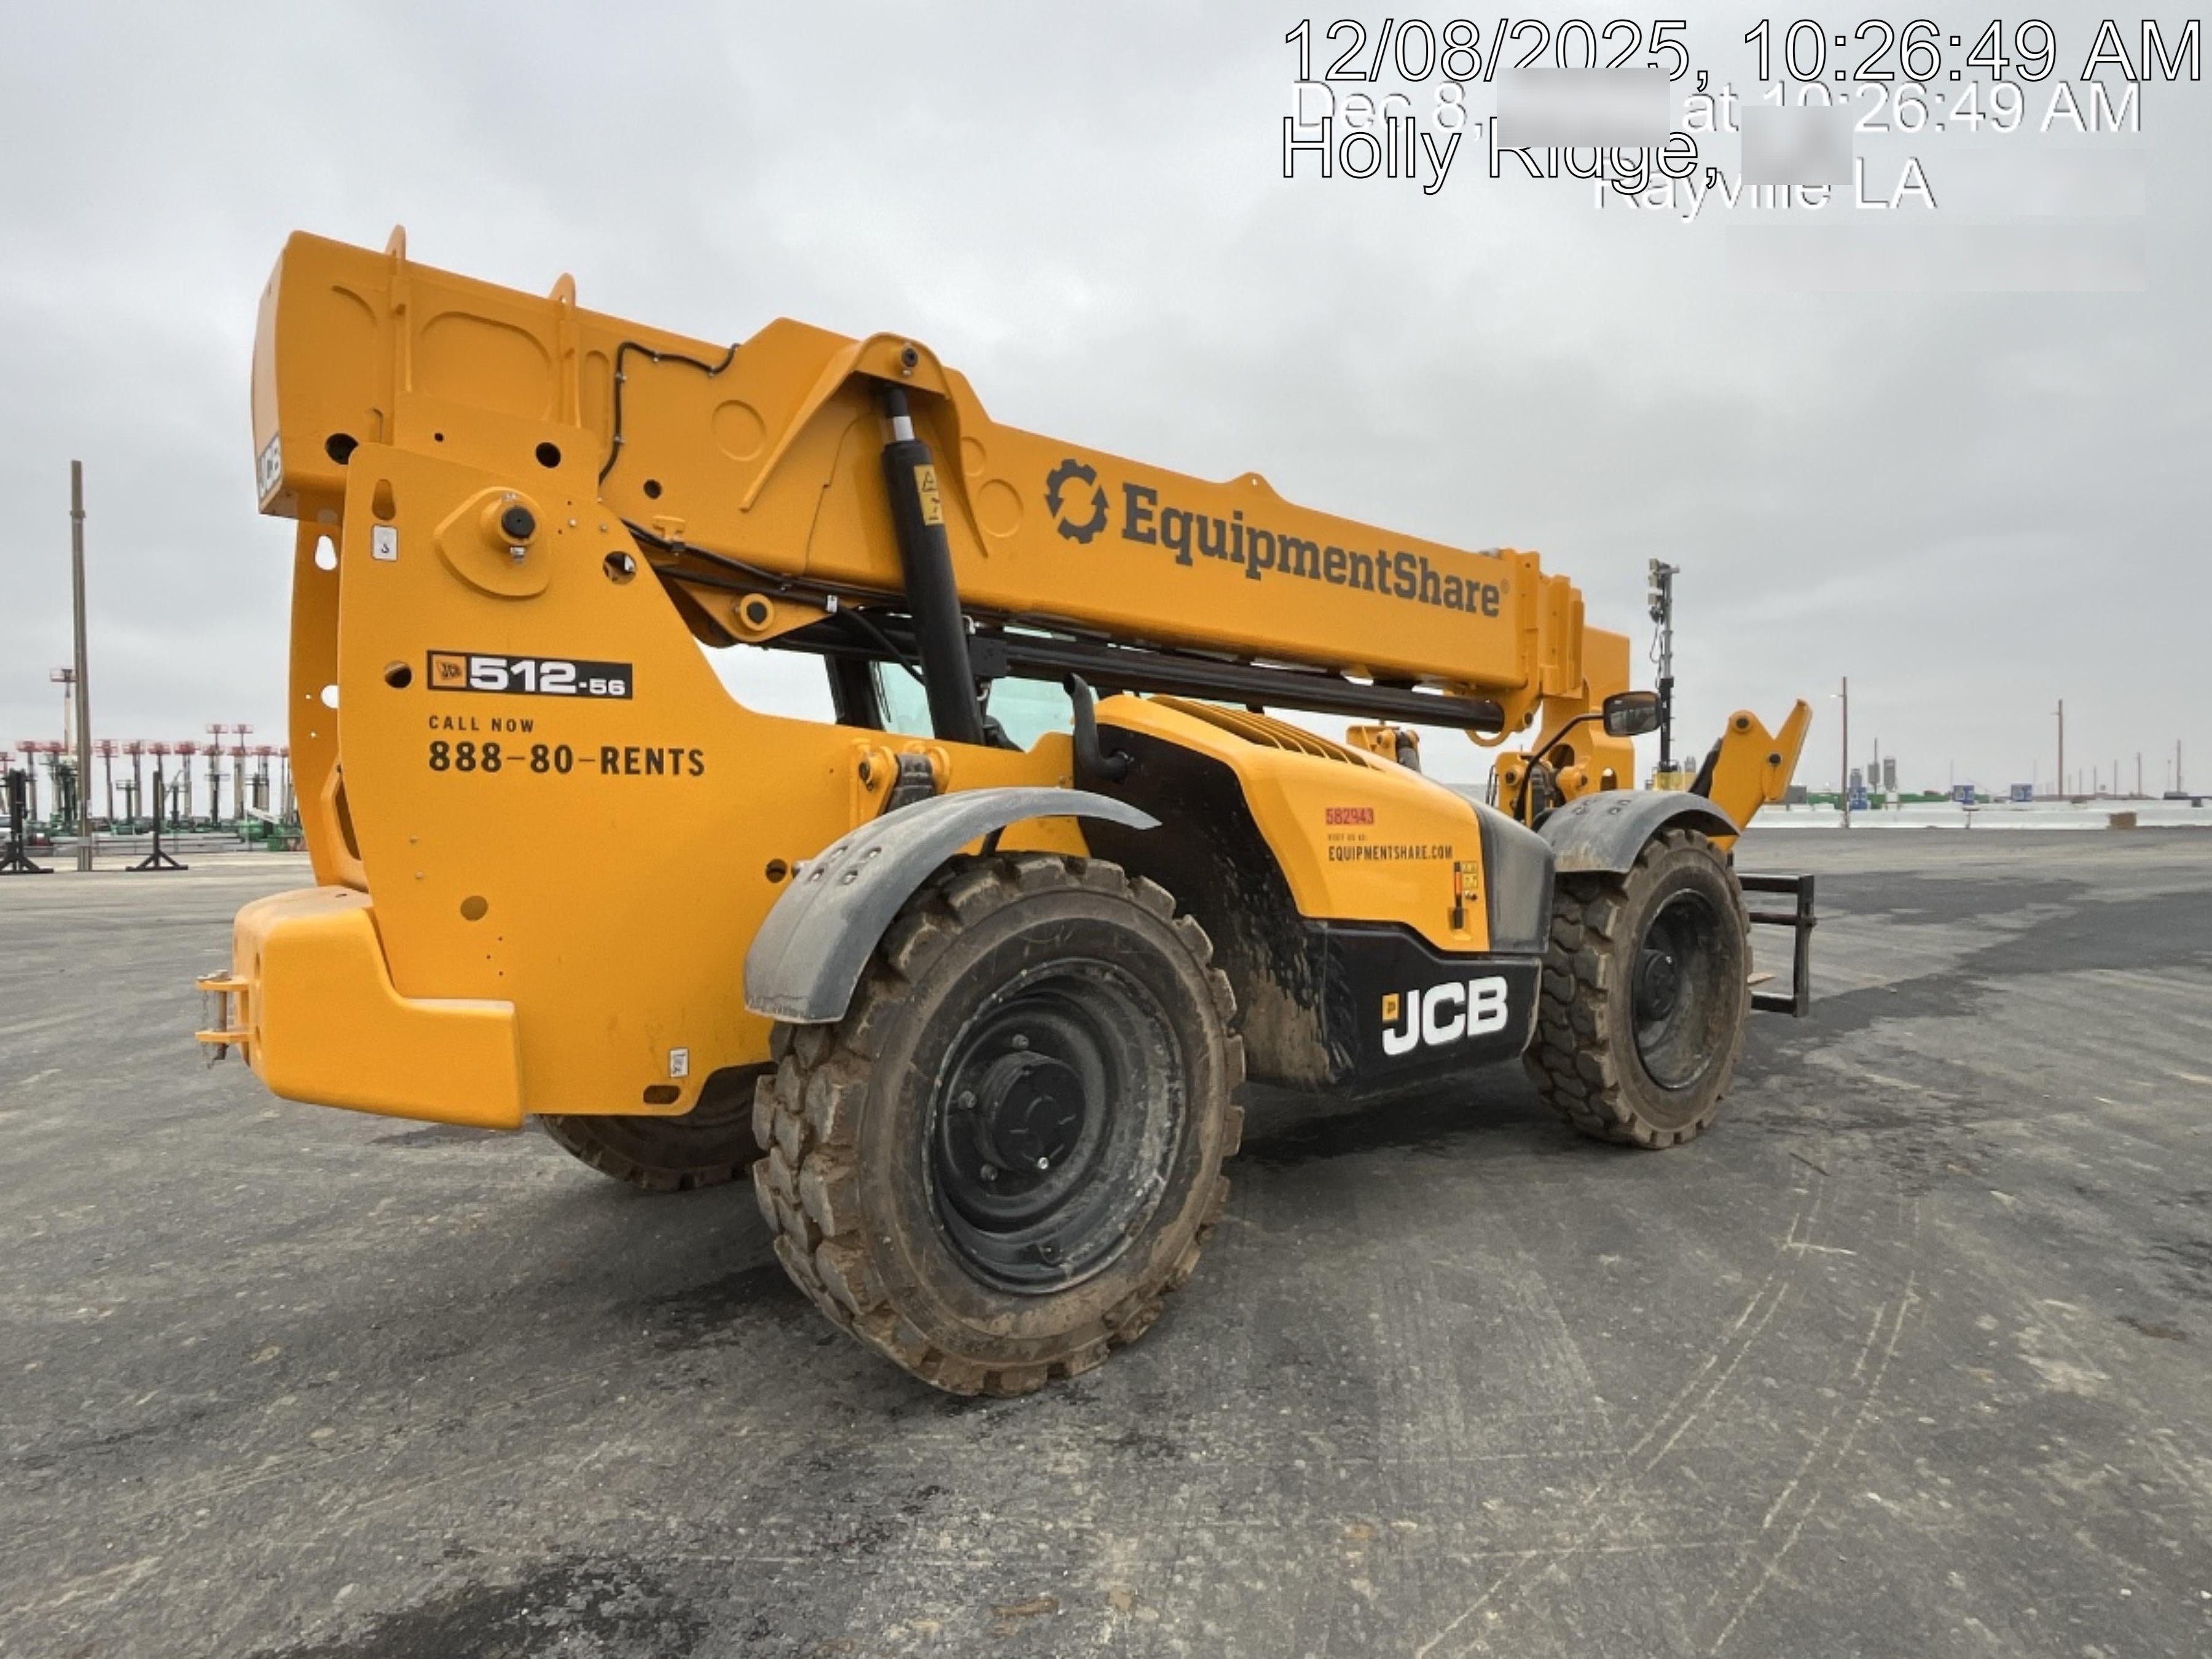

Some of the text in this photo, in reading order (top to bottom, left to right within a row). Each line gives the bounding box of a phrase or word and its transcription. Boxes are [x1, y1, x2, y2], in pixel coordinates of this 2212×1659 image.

[1121, 482, 1500, 618] EquipmentShare
[469, 656, 626, 697] 512-56
[429, 715, 535, 734] CALL NOW
[429, 740, 705, 777] 888-80-RENTS
[1328, 845, 1453, 861] EQUIPMENTSHARE.COM
[1382, 976, 1508, 1056] JCB
